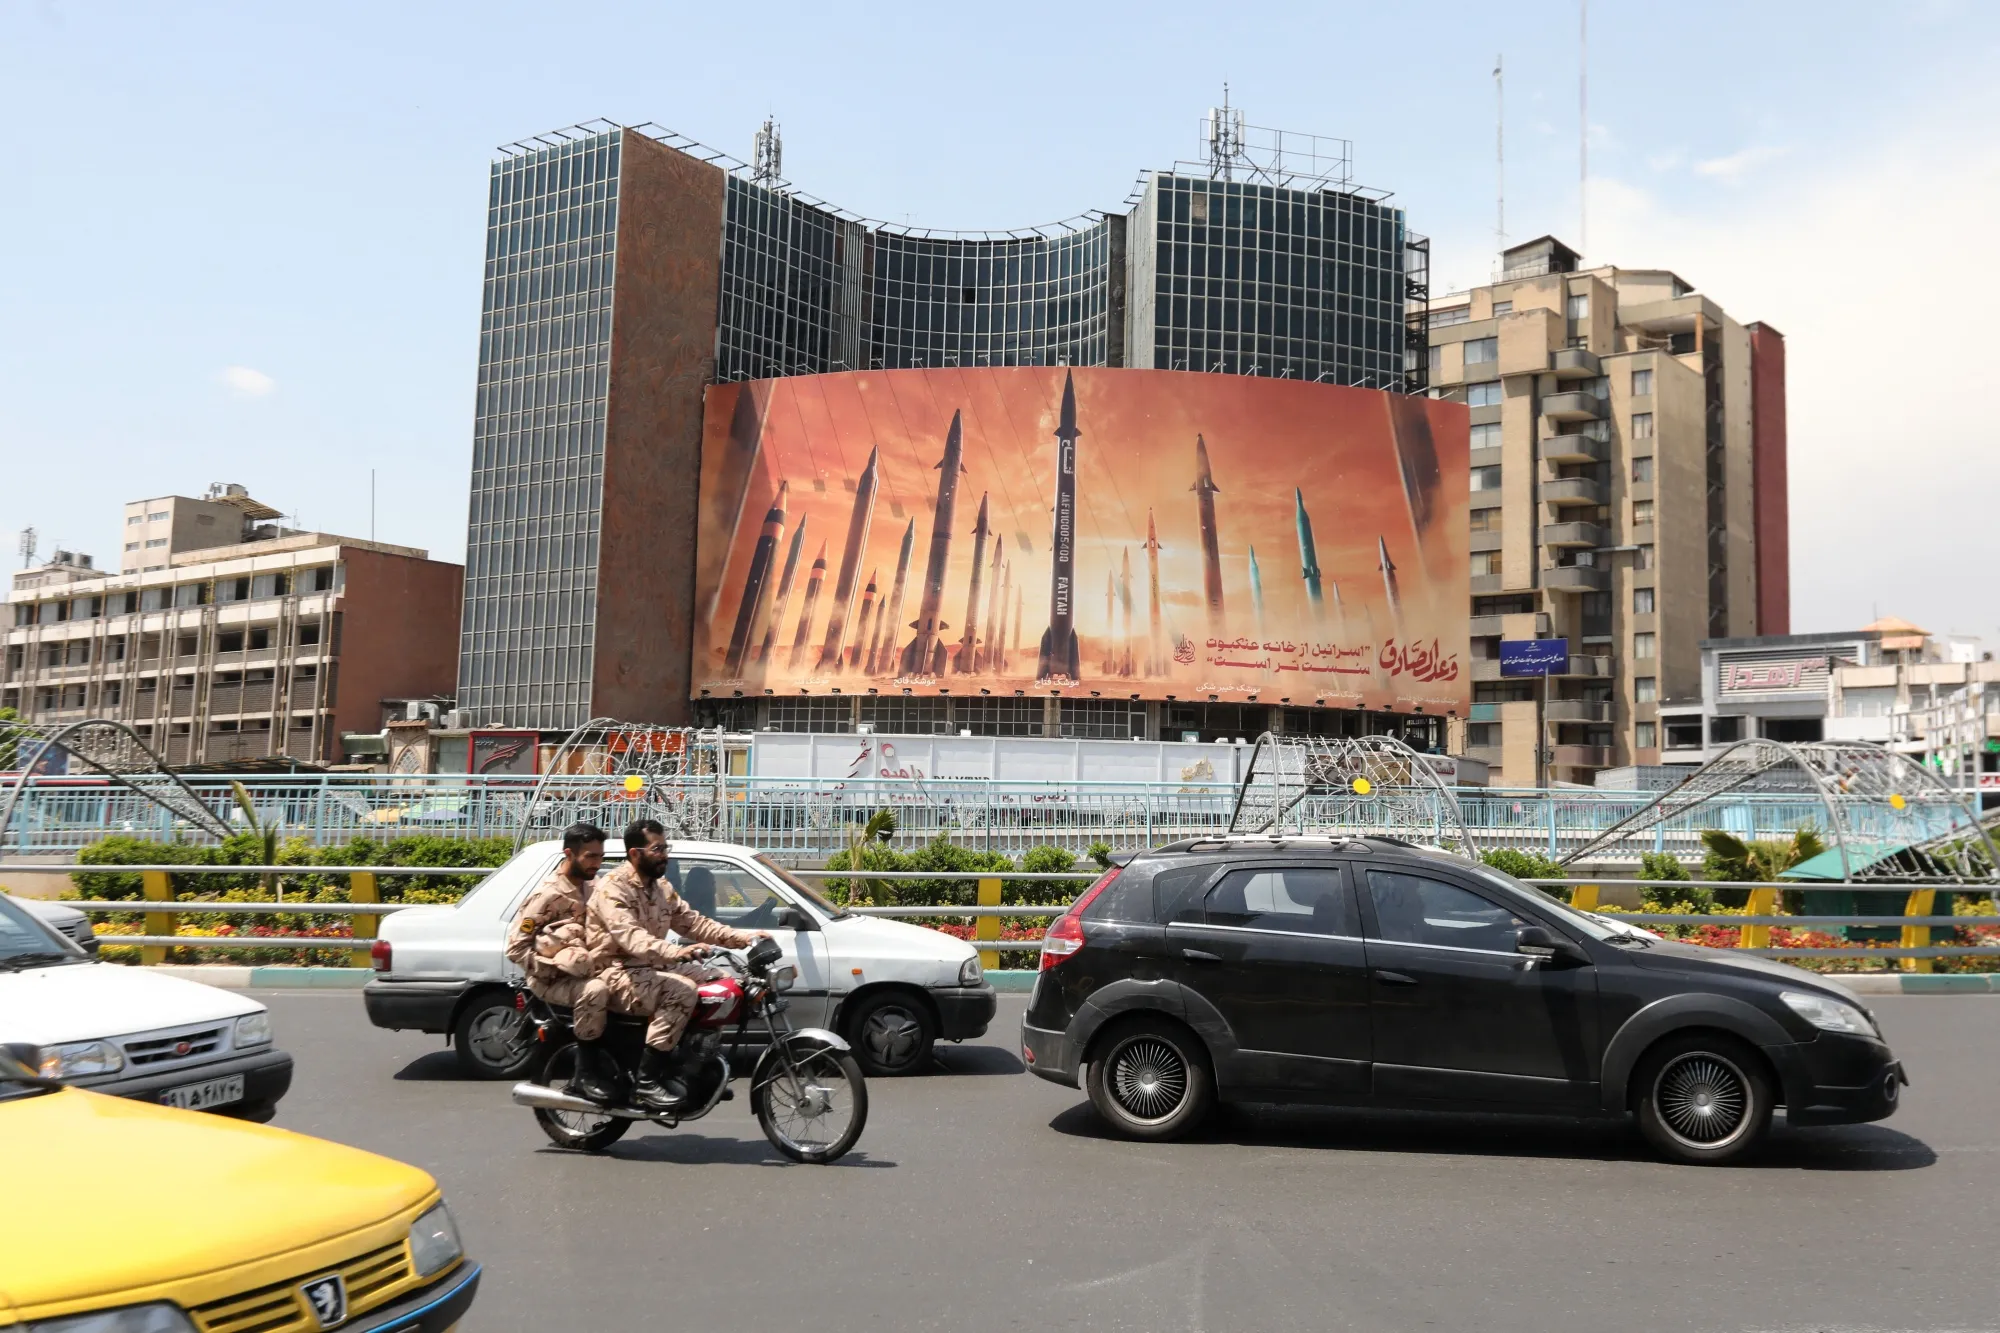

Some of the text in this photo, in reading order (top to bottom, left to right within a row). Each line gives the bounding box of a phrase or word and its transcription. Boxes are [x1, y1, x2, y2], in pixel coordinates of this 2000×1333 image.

[1056, 576, 1069, 616] FATTAH
[1206, 637, 1260, 653] عنکبوت
[1263, 640, 1297, 653] خانه
[1299, 641, 1309, 657] از
[1275, 659, 1300, 673] تر
[910, 677, 936, 687] موشک
[1053, 677, 1080, 688] موشک
[1195, 682, 1216, 692] شکن
[1236, 684, 1262, 695] موشک
[1340, 689, 1363, 699] موشک
